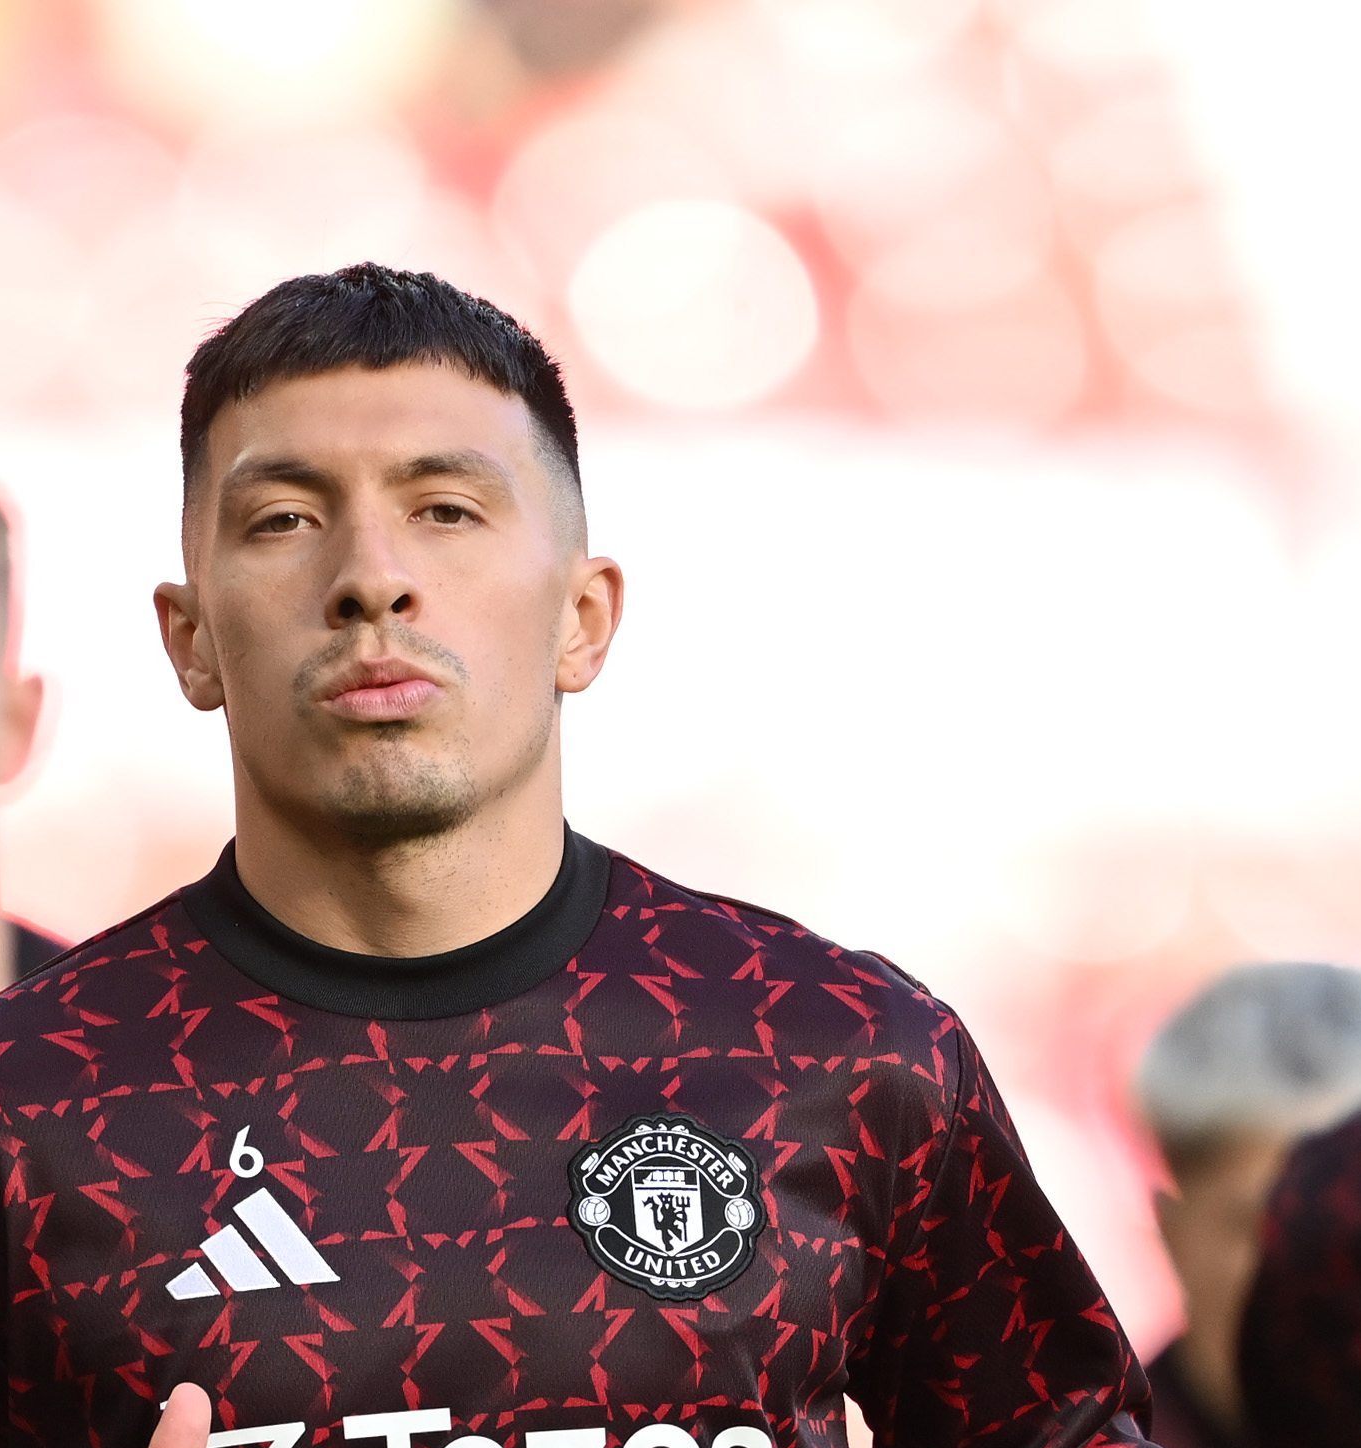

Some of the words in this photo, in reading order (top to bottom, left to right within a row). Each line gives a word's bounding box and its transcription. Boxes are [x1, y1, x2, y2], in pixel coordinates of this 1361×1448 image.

[229, 1124, 264, 1178] 6
[595, 1135, 735, 1189] MANCHESTER
[624, 1246, 721, 1277] UNITED
